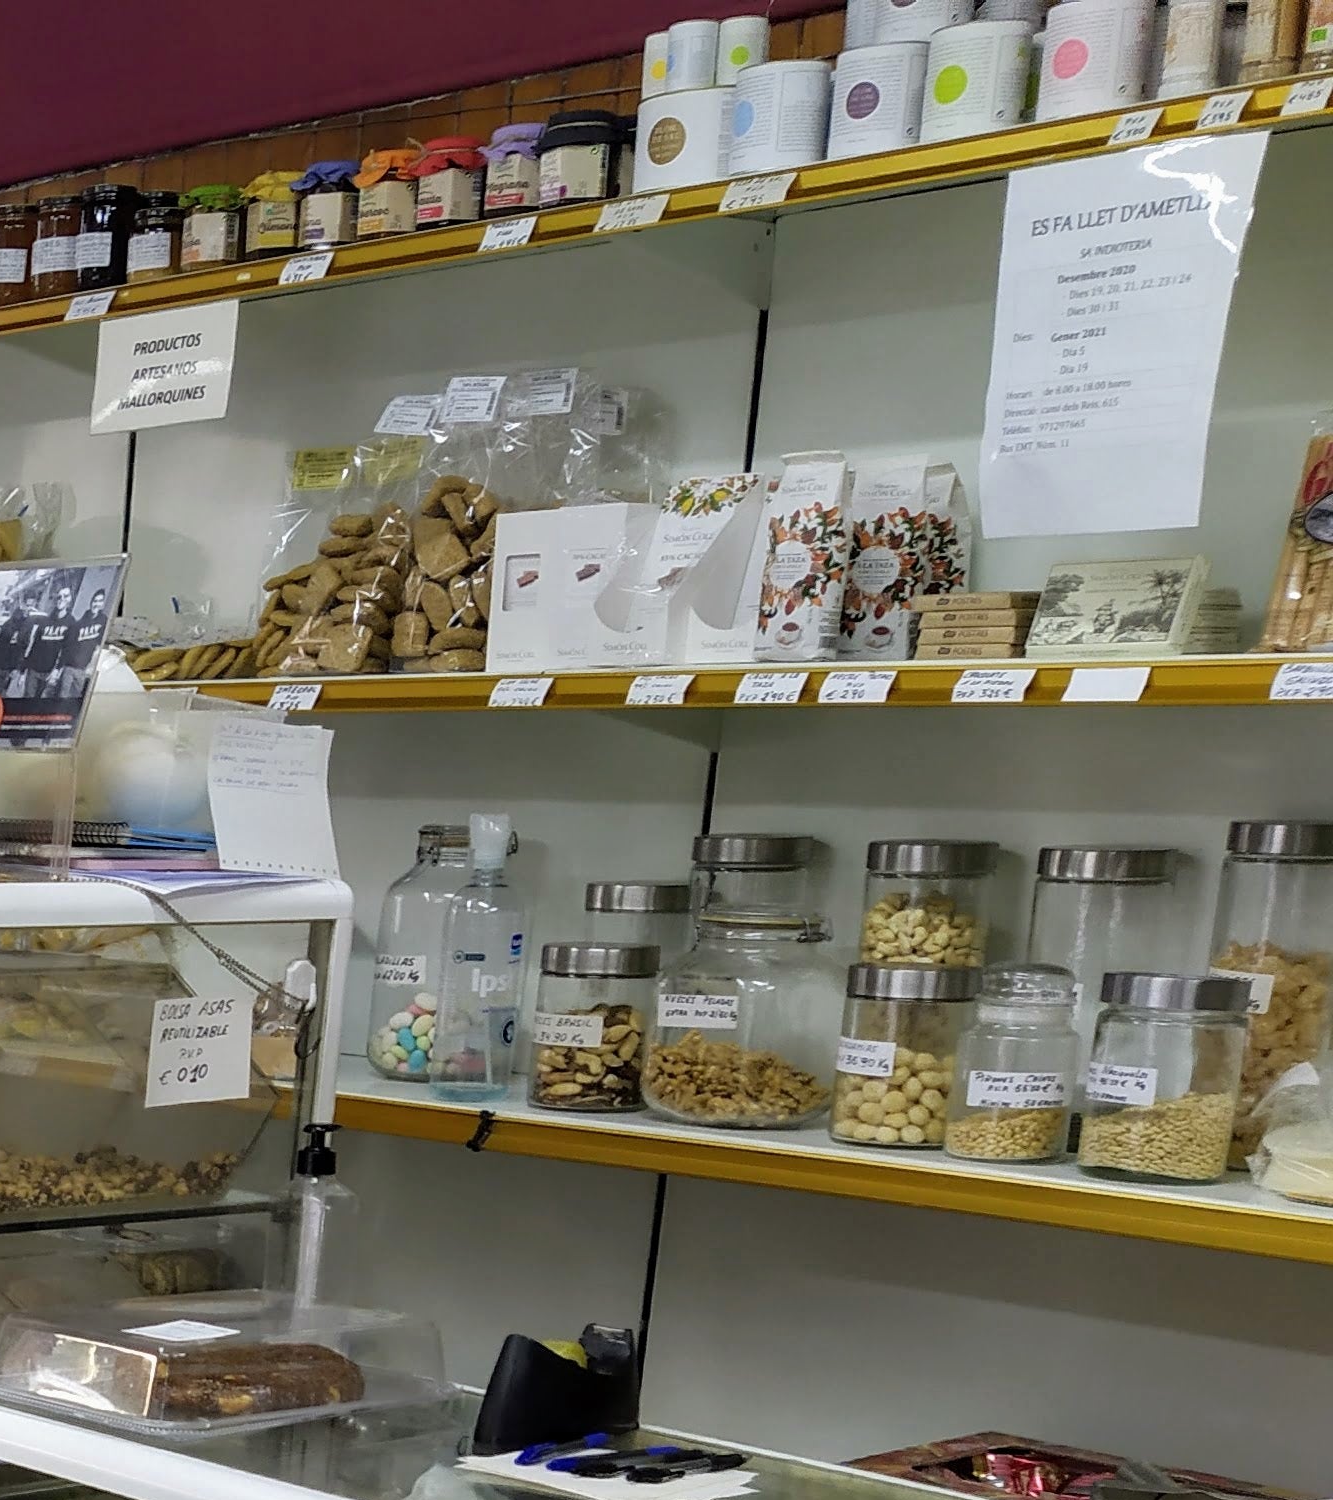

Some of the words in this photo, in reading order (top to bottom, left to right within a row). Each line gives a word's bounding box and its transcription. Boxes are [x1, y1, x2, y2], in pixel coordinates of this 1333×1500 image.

[1031, 217, 1051, 238] ES
[1053, 214, 1075, 235] FA
[1076, 206, 1118, 231] LLET
[1056, 269, 1109, 286] Desembre
[1109, 264, 1137, 280] 2020
[132, 332, 203, 357] PRODUCTOS
[1050, 330, 1081, 344] Gener
[1082, 326, 1108, 339] 2021
[130, 360, 199, 384] ARTESANOS
[117, 384, 207, 411] MALLORQUINES
[159, 1003, 192, 1021] BOLSA
[198, 999, 236, 1016] ASAS
[159, 1024, 230, 1044] REUTILIZABLE
[158, 1069, 172, 1086] €
